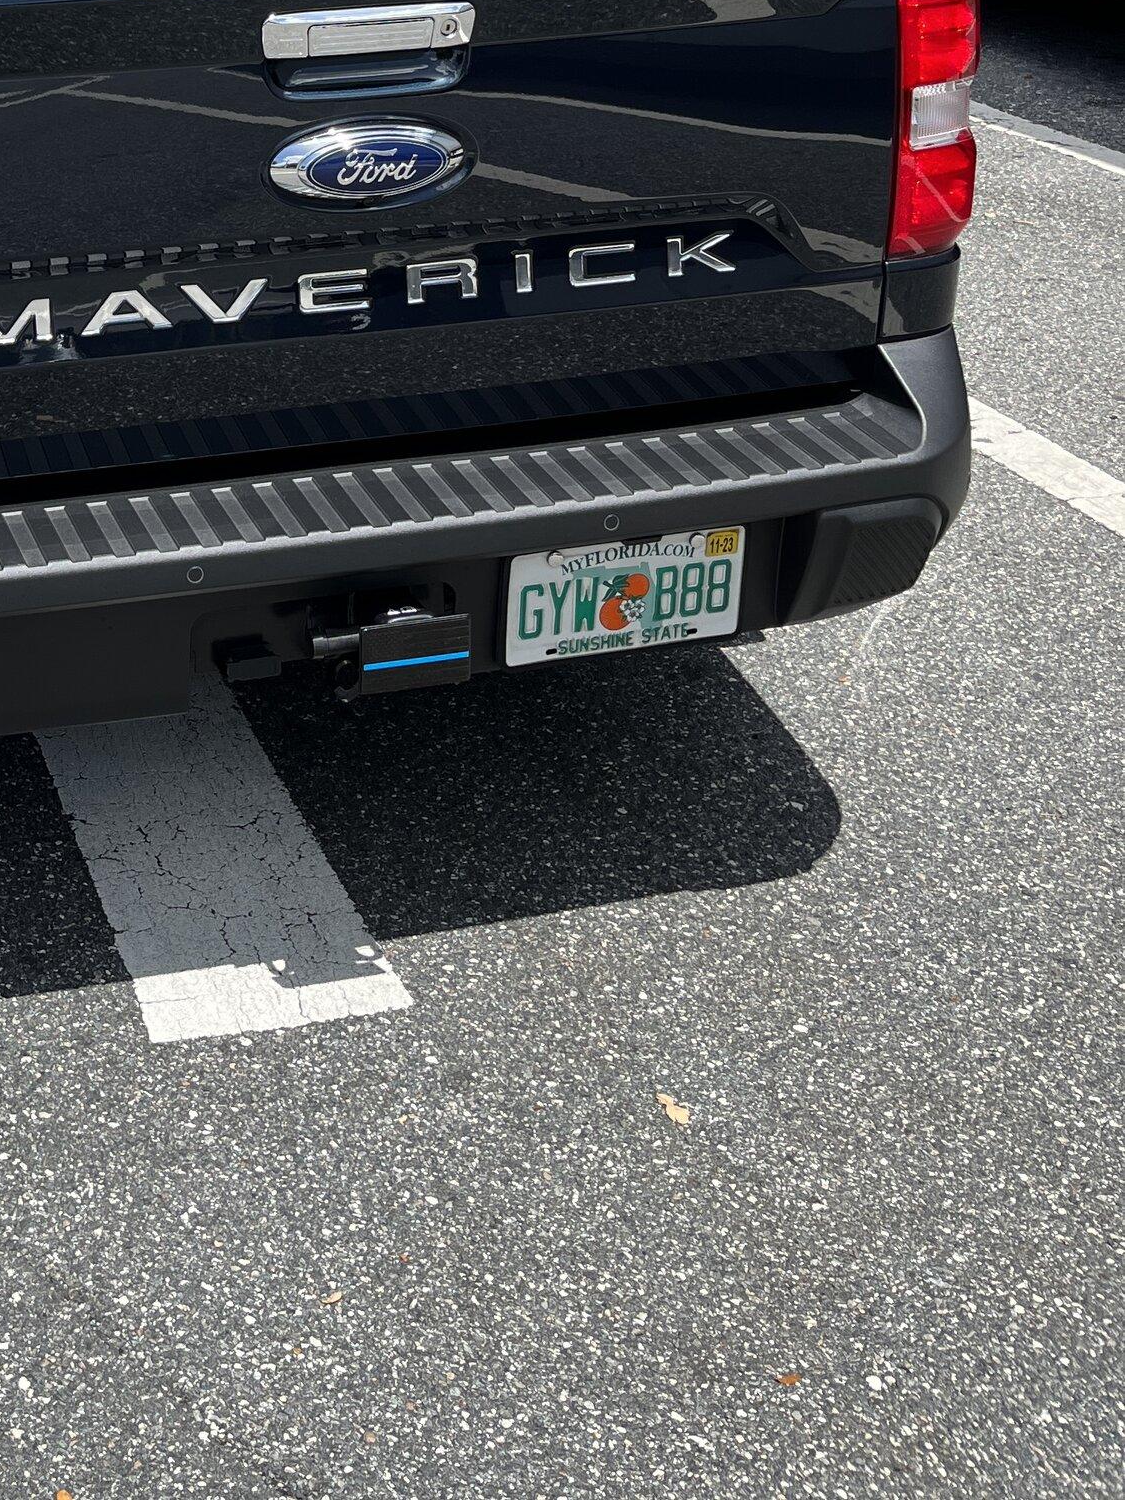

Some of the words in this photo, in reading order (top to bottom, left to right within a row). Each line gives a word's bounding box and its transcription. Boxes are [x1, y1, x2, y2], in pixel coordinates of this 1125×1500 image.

[336, 148, 419, 186] Ford
[561, 542, 695, 576] MYFLORIDA.COM
[709, 536, 734, 554] 11-23
[518, 576, 599, 640] GYW
[652, 558, 732, 622] B88
[557, 630, 634, 655] SUNSHINE
[641, 622, 690, 644] STATE
